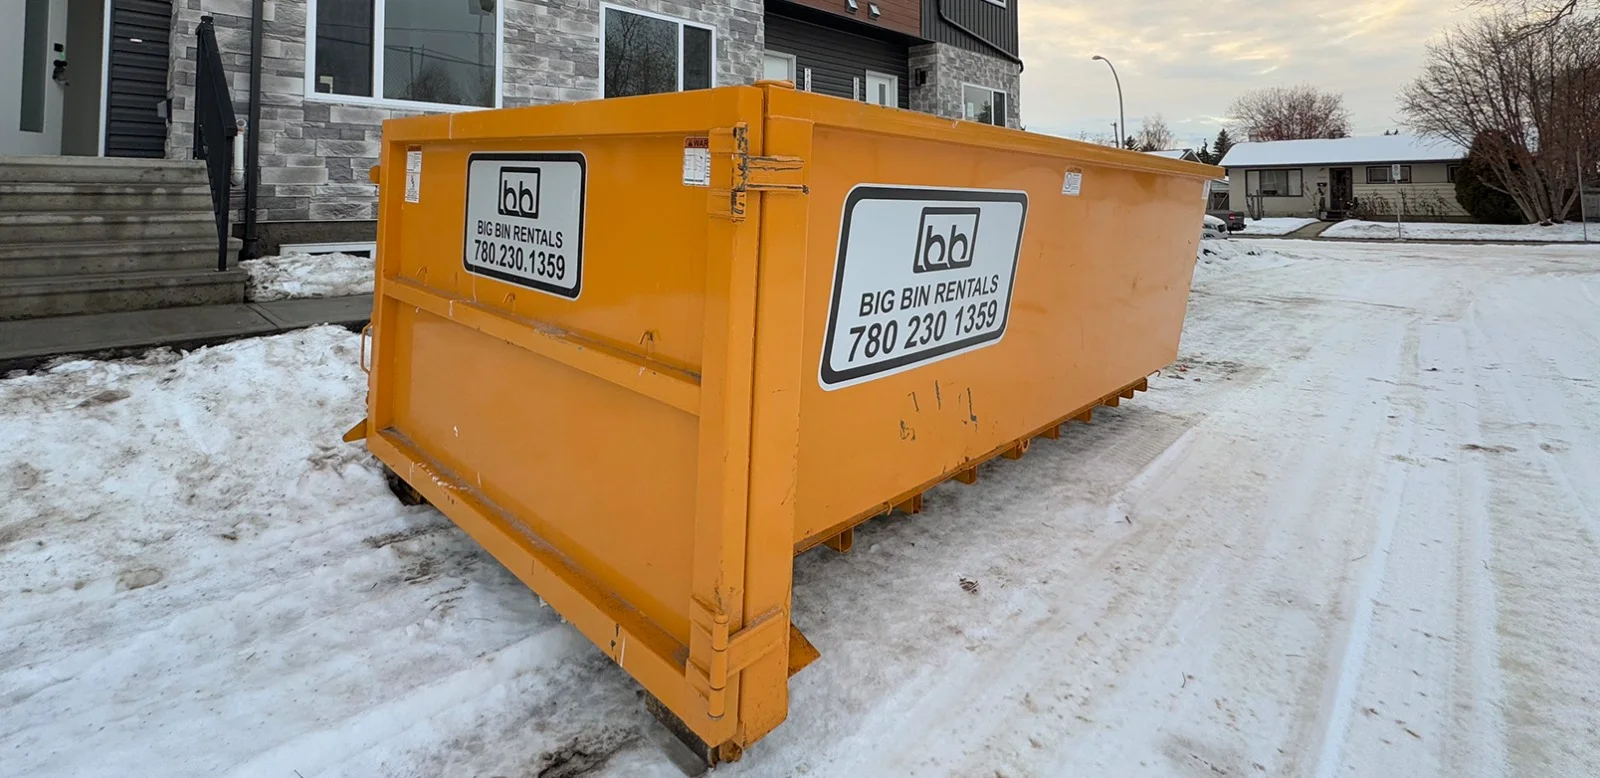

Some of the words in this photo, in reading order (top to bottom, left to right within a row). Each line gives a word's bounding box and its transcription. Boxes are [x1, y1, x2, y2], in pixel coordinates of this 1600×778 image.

[477, 220, 493, 237] BIG
[495, 222, 511, 240] BIN
[513, 225, 563, 249] RENTALS
[474, 239, 565, 280] 780.230.1359
[859, 289, 895, 317] BIG
[900, 284, 931, 310] BIN
[934, 274, 999, 304] RENTALS
[848, 319, 898, 362] 780
[904, 310, 947, 349] 230
[954, 299, 998, 336] 1359
